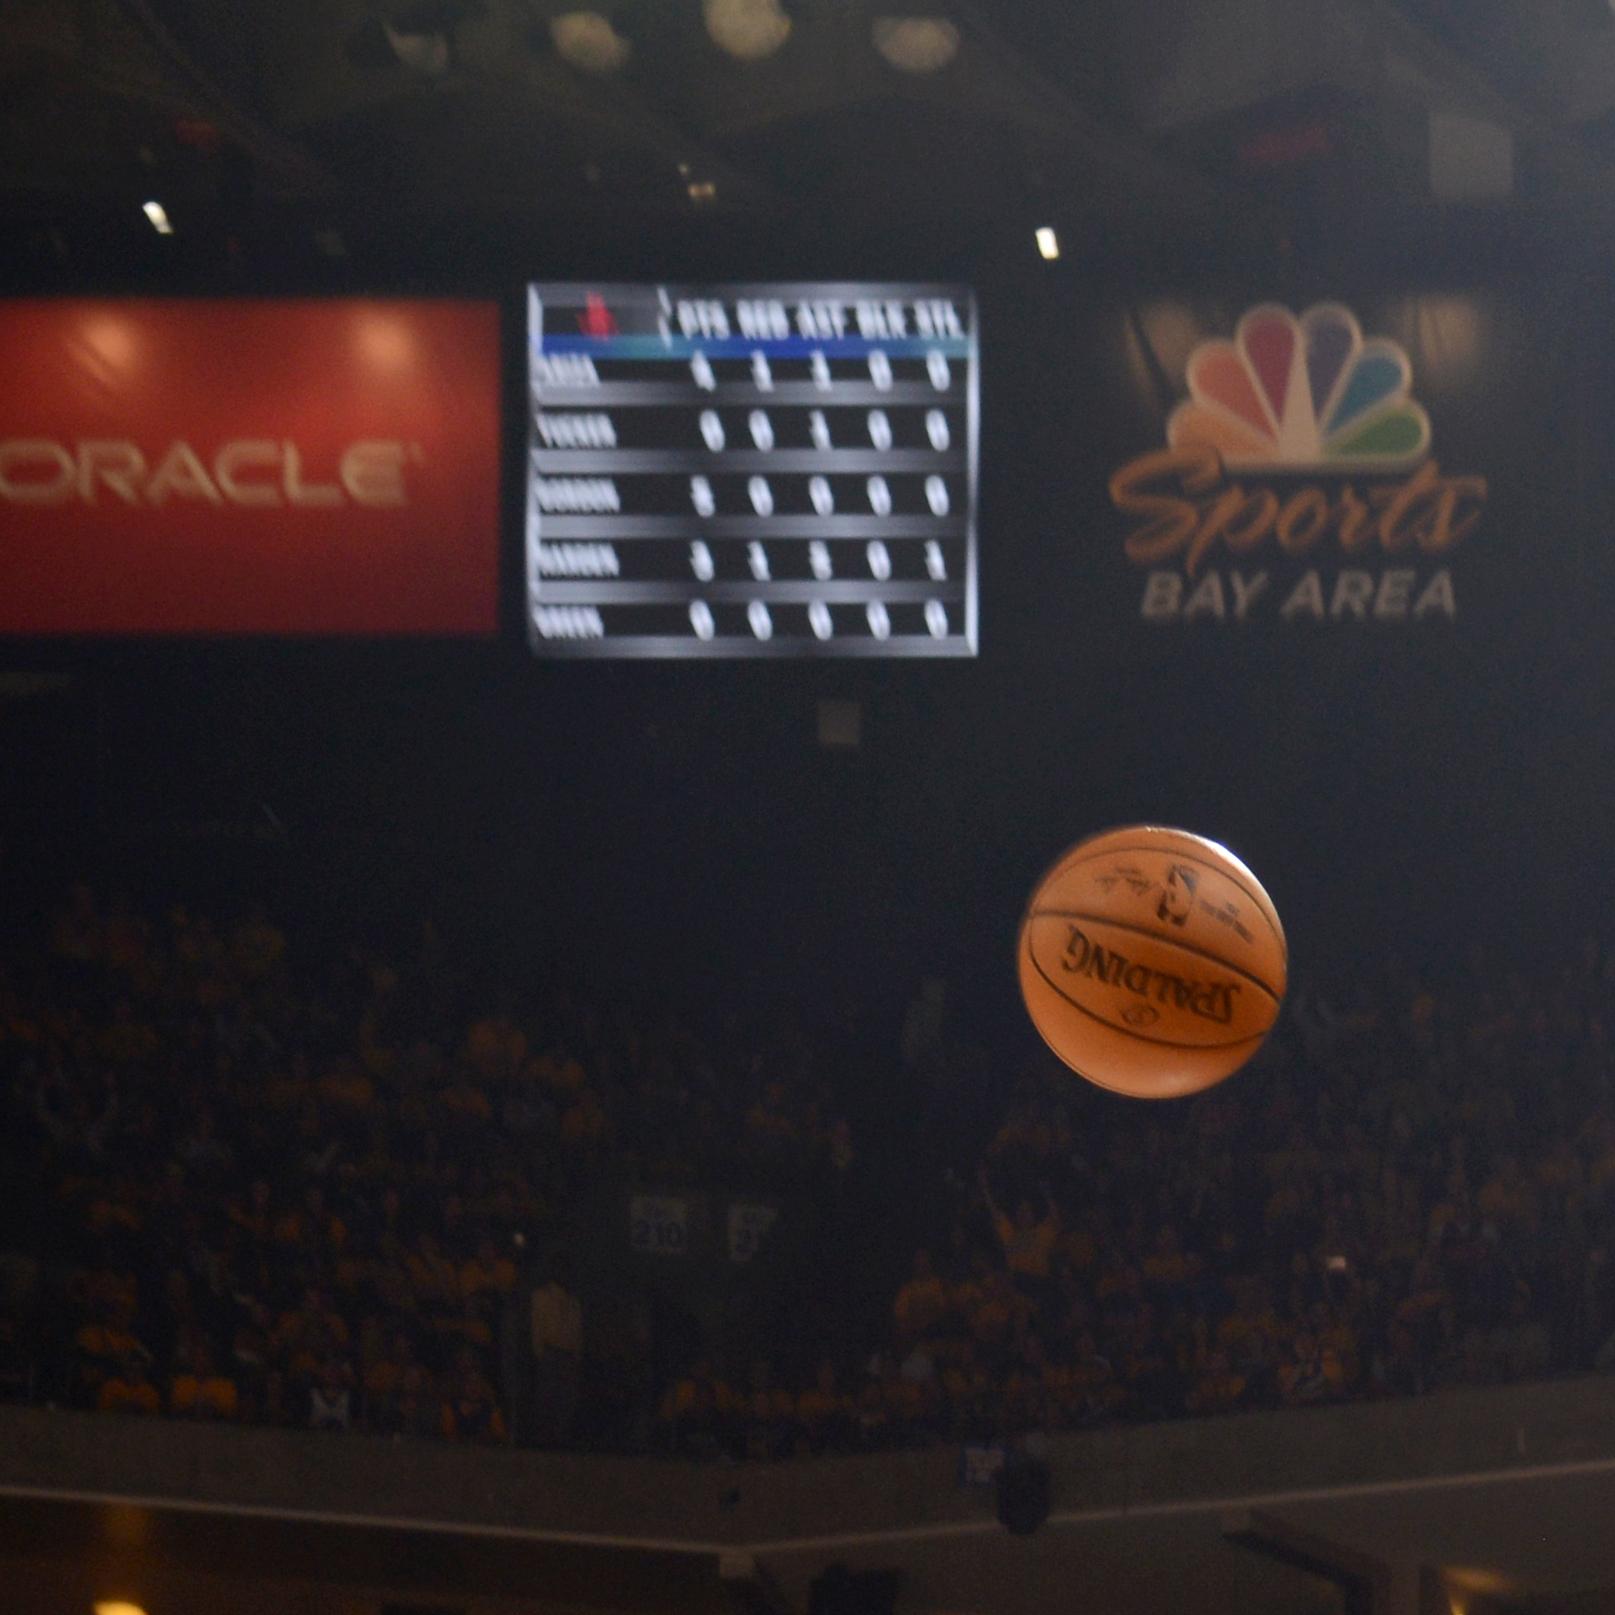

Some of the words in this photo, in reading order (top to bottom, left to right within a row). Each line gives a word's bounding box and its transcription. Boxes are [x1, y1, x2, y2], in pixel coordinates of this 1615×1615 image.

[0, 438, 406, 500] ORACLE
[1108, 448, 1488, 578] Sports
[1140, 570, 1268, 620] BAY
[1280, 570, 1456, 620] AREA
[1060, 924, 1243, 1024] SPALDING
